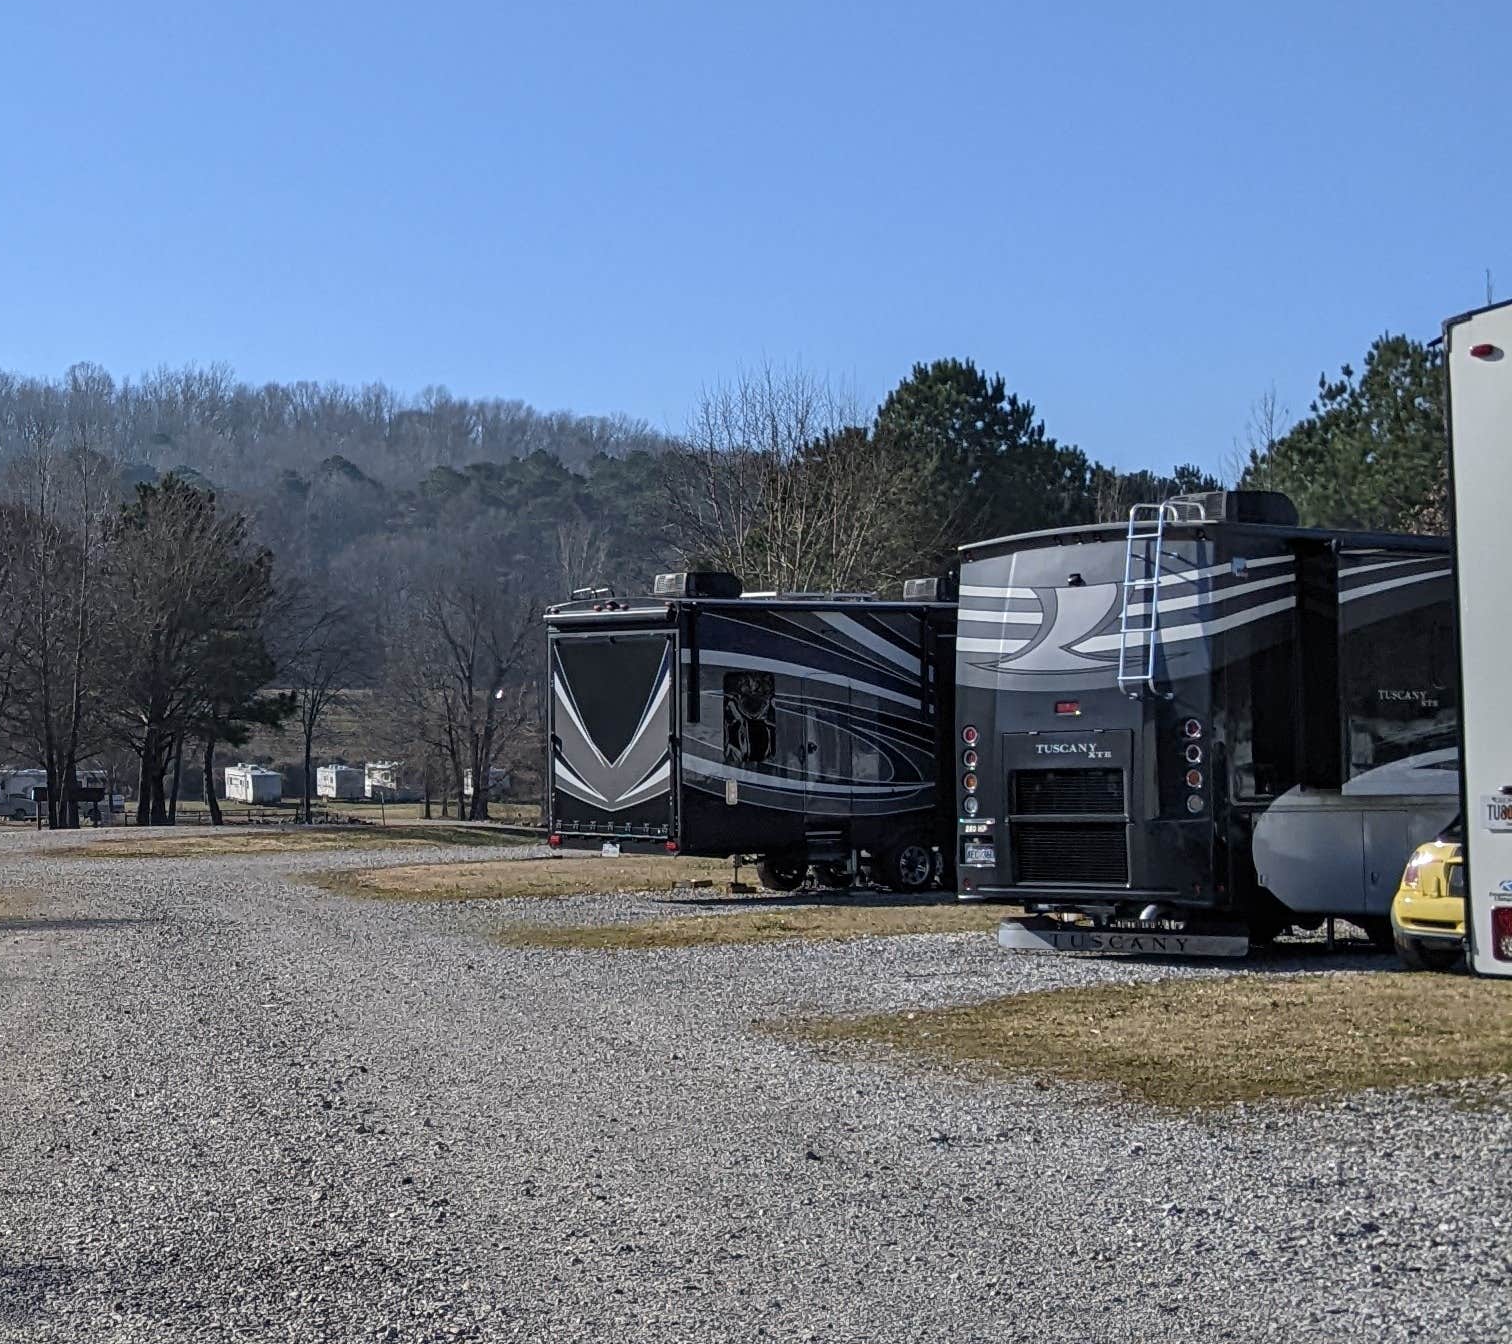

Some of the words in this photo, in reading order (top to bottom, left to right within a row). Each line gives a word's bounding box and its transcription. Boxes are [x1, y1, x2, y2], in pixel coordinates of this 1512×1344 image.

[1377, 689, 1427, 701] TUSCANY
[1035, 743, 1097, 754] TUSCANY
[1049, 933, 1188, 952] TUSCANY
